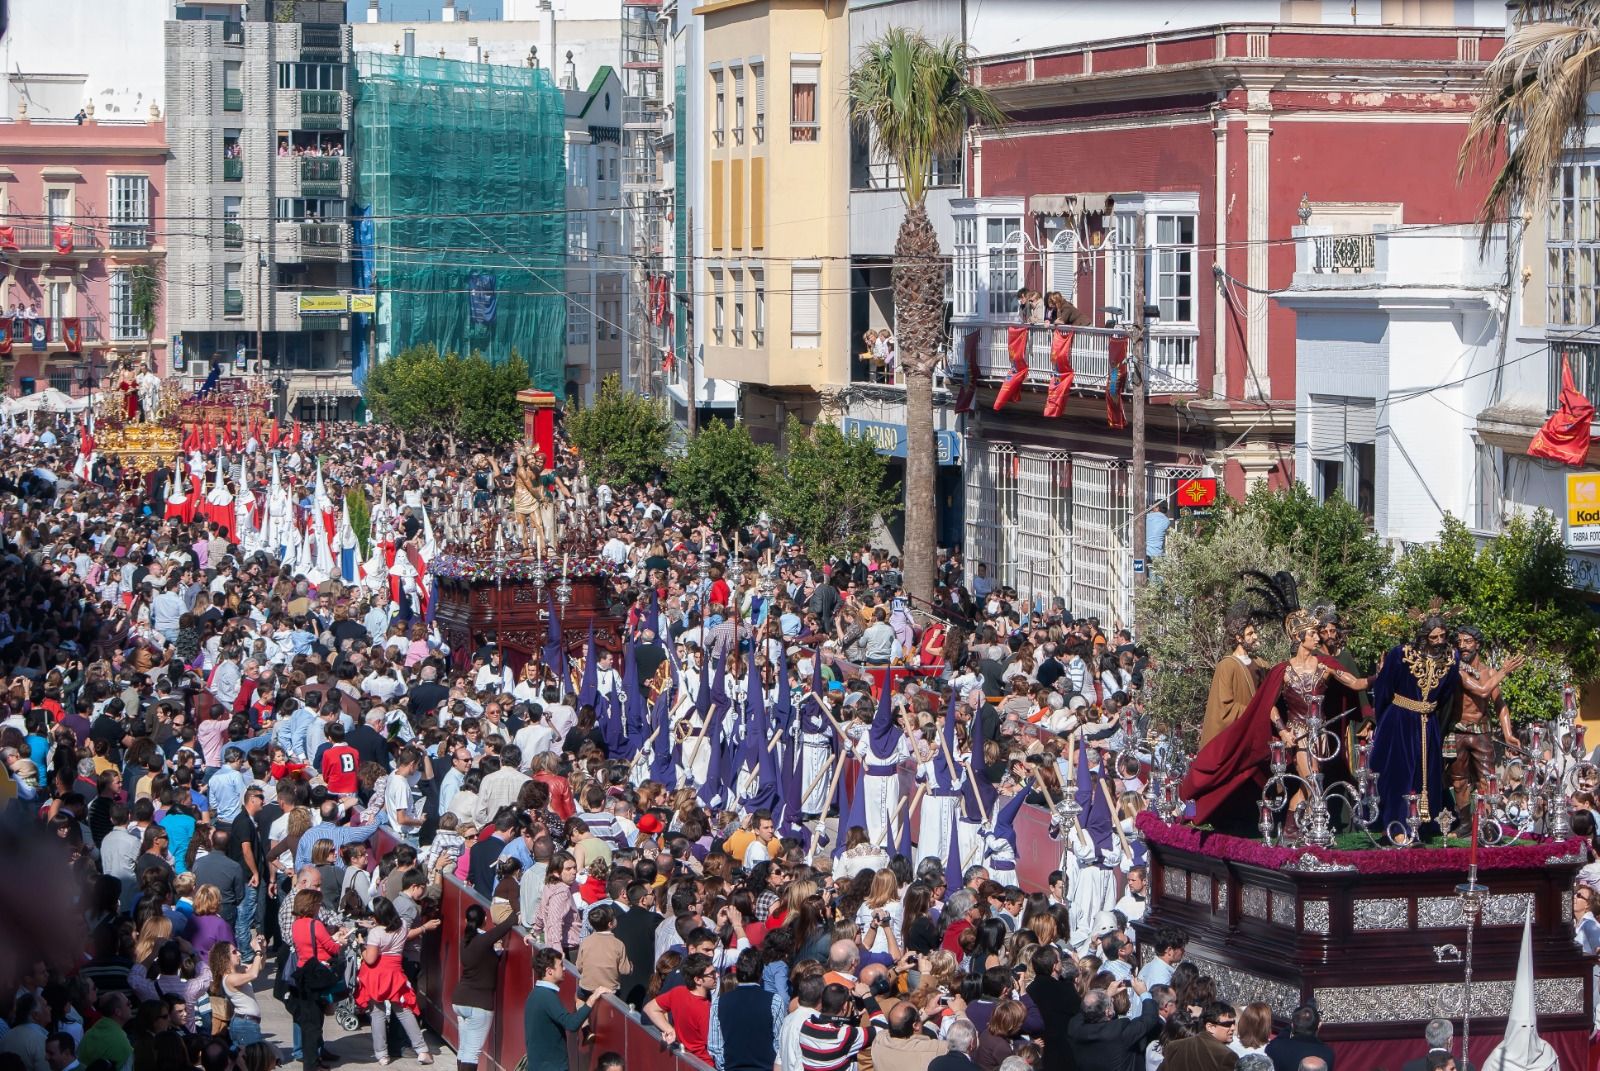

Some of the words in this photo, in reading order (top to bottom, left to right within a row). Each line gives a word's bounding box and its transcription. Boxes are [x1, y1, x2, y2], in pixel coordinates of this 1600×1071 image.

[1577, 510, 1600, 522] Kod
[1573, 532, 1589, 542] FABRA
[341, 753, 354, 772] B
